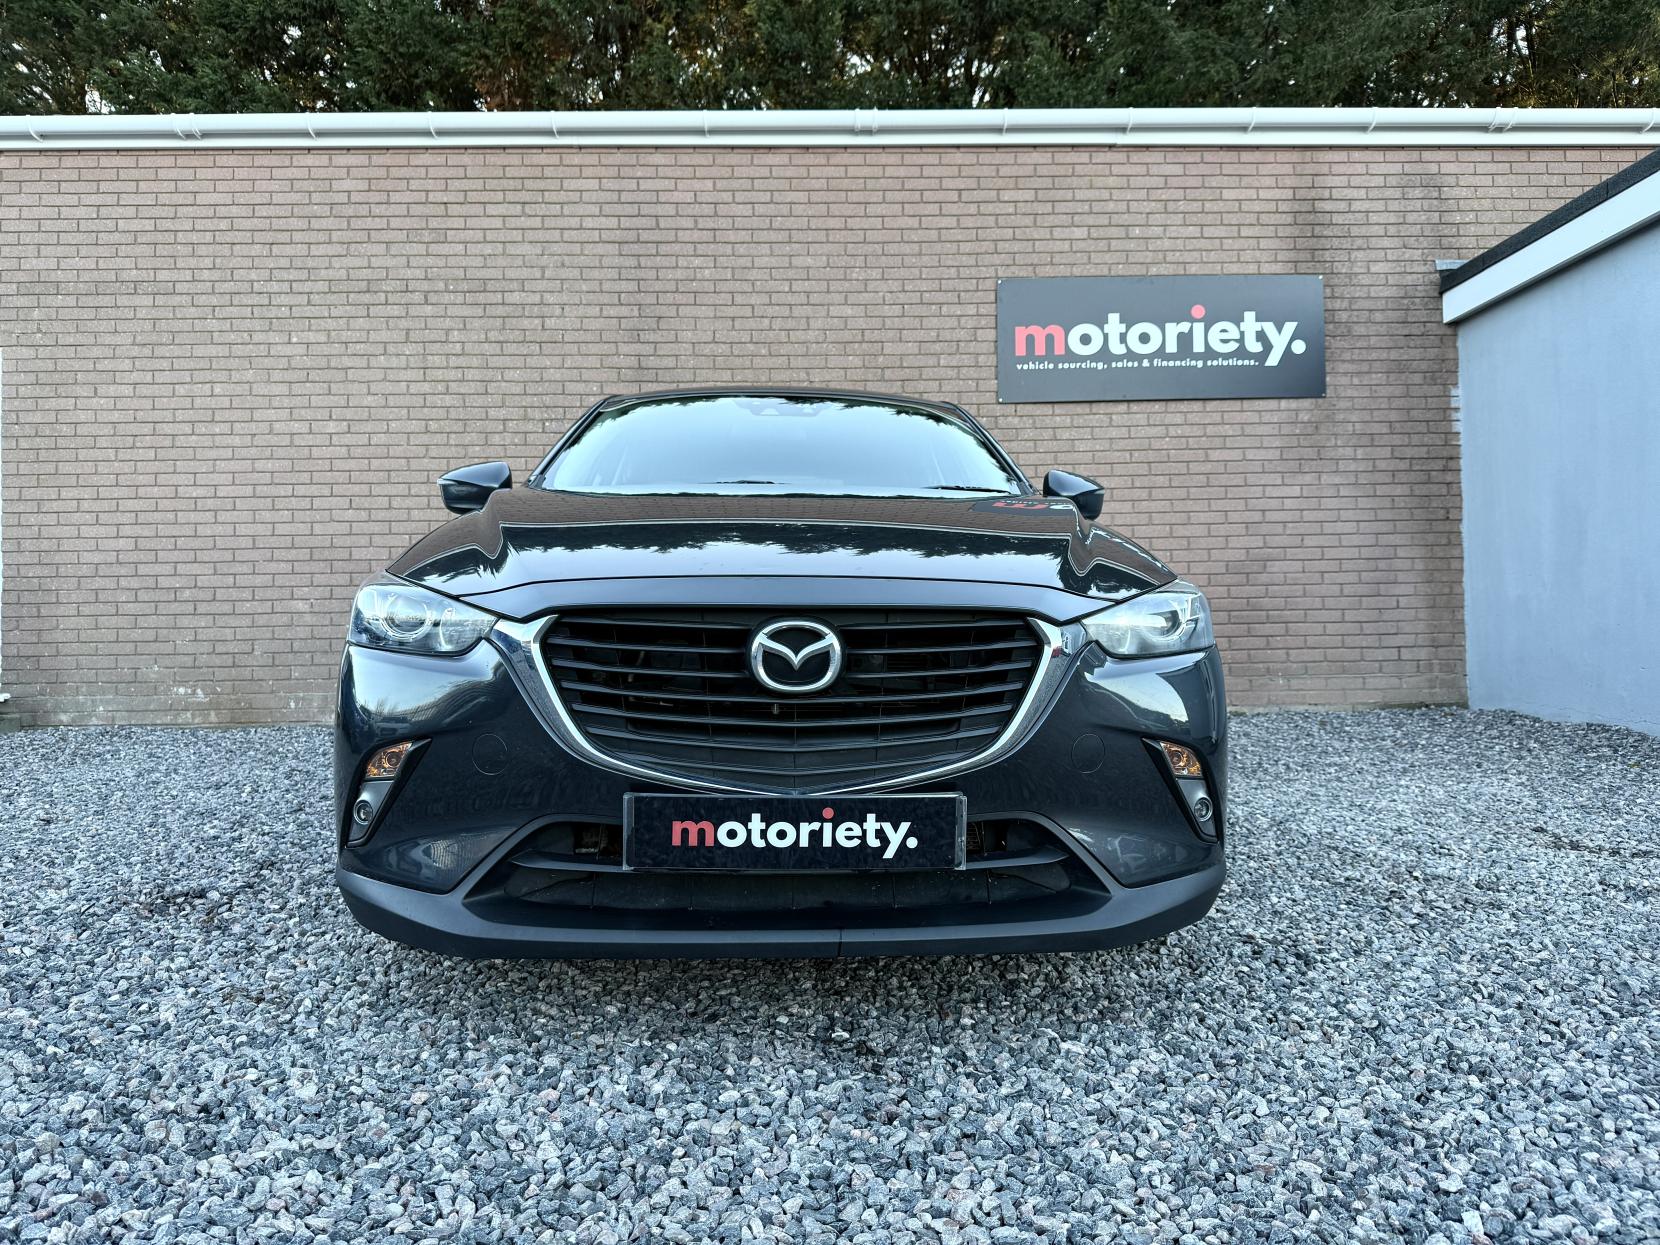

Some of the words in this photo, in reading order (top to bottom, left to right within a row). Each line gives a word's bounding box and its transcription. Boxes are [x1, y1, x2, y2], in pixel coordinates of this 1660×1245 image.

[1014, 304, 1306, 367] motoriety.
[1016, 361, 1055, 370] vehicle
[1058, 360, 1108, 370] sourcing,
[1111, 359, 1139, 368] sales
[1141, 358, 1150, 367] &
[1153, 358, 1203, 368] financing
[1206, 357, 1260, 366] solutions.
[671, 807, 918, 859] motoriety.
